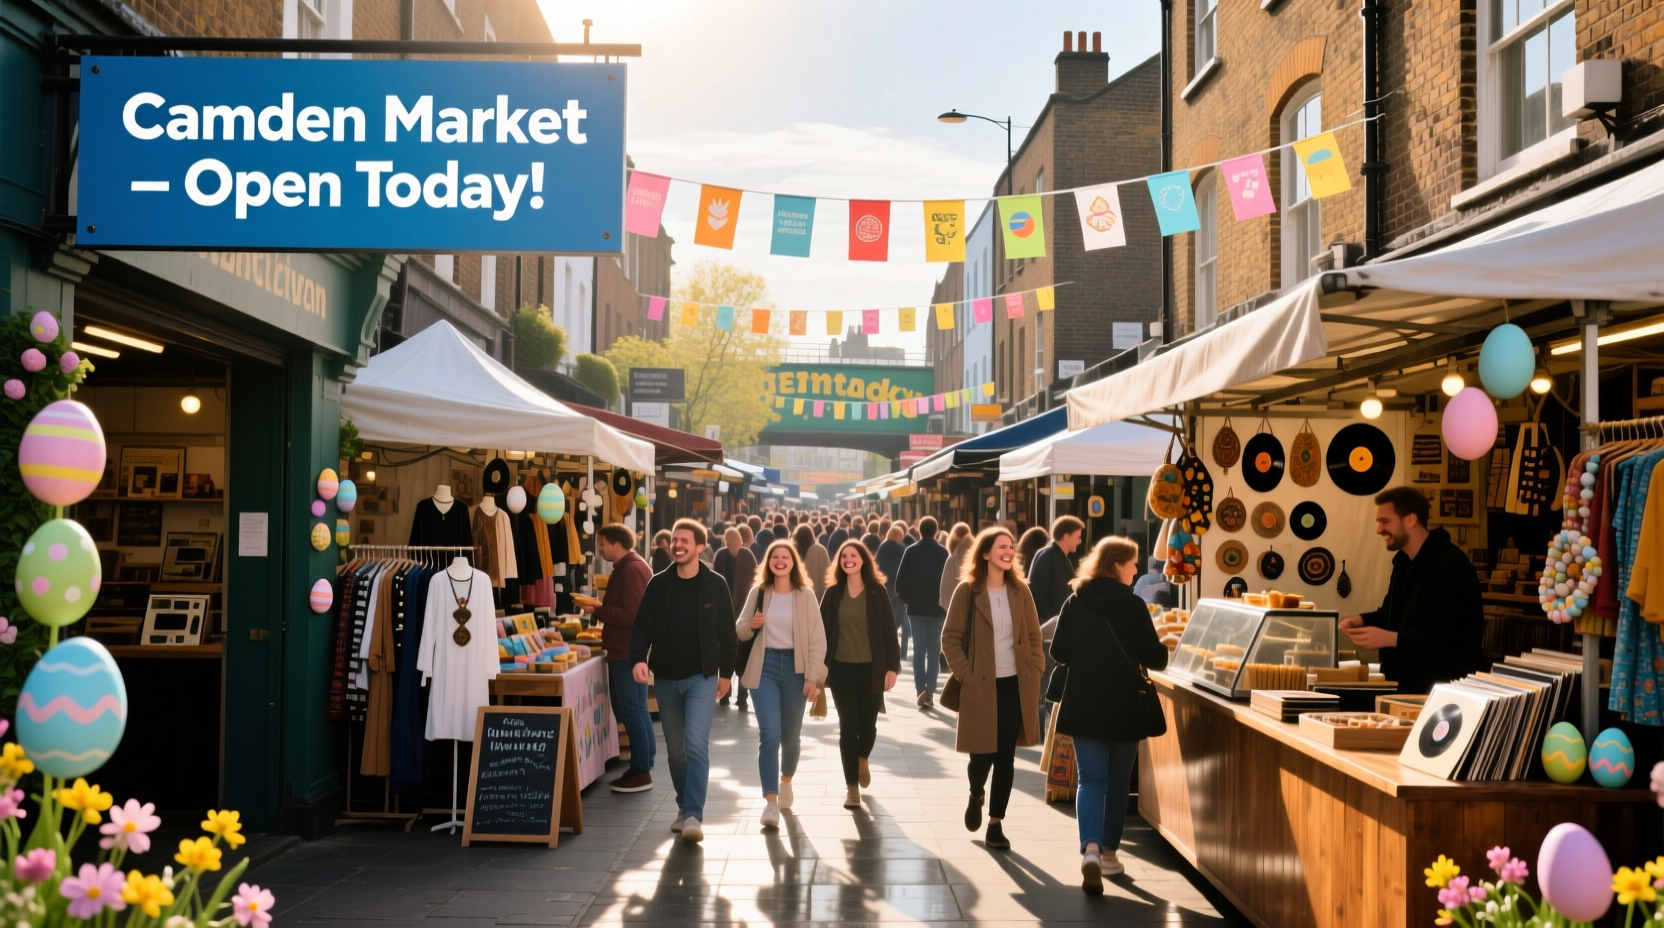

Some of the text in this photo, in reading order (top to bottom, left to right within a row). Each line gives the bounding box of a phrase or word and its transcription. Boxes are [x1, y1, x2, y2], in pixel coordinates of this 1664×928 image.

[122, 92, 588, 145] Camden Market
[184, 158, 342, 220] Open
[355, 159, 545, 222] Today!
